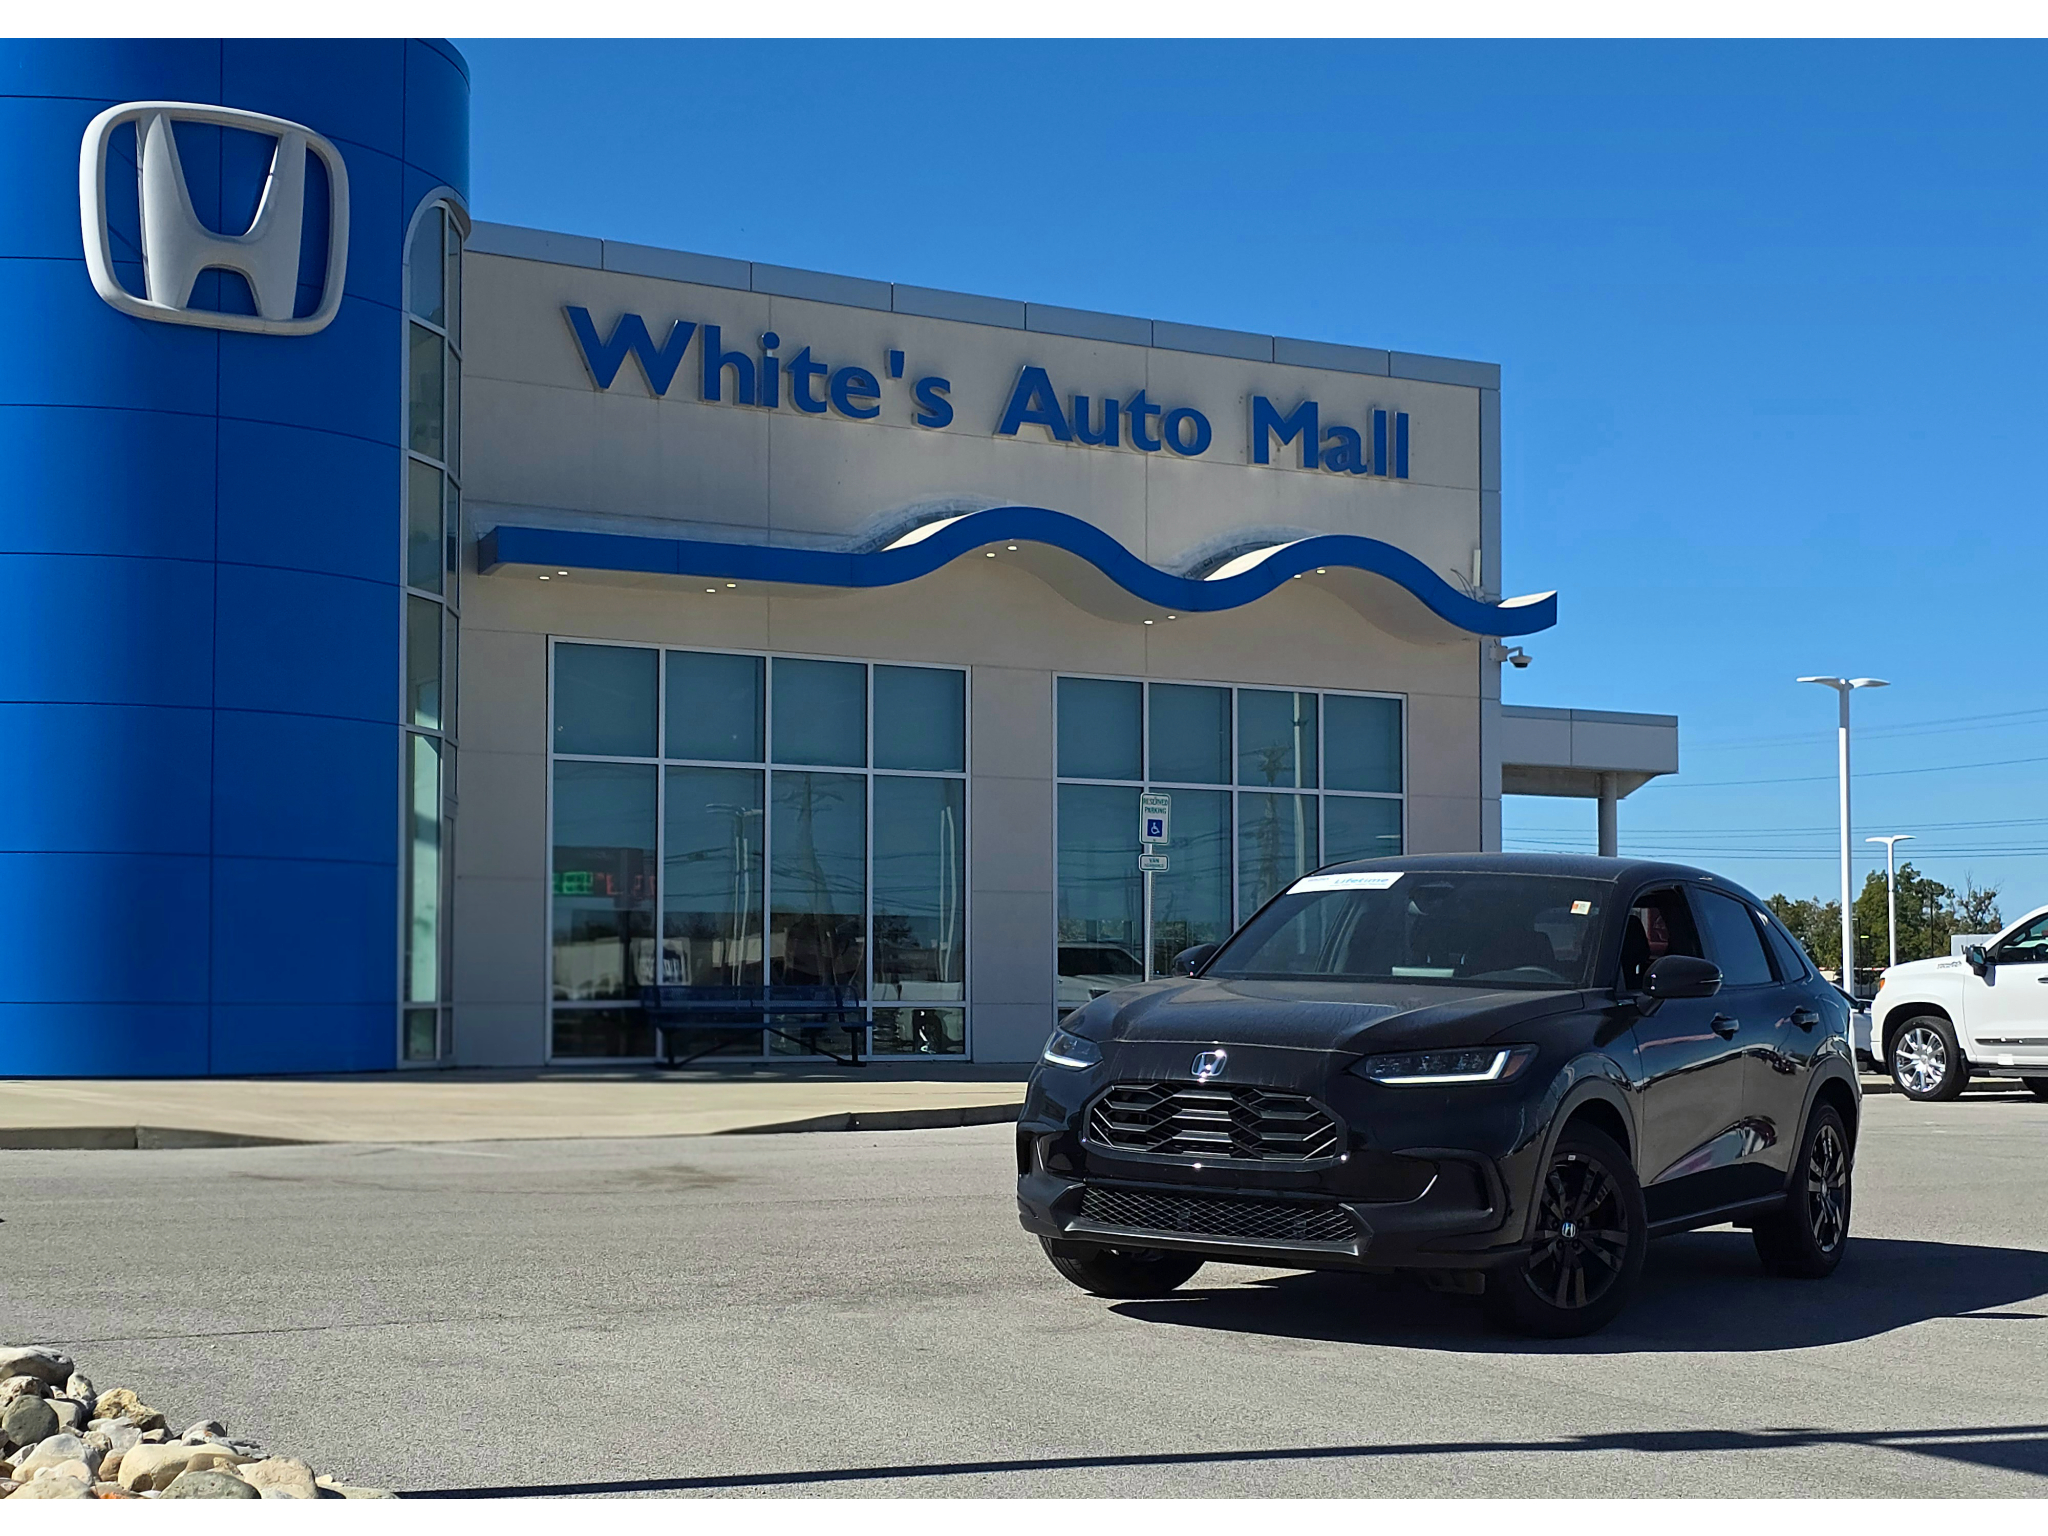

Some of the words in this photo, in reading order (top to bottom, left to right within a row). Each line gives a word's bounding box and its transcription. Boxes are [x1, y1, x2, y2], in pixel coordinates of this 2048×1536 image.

[564, 305, 954, 430] White's
[996, 365, 1213, 458] Auto
[1249, 393, 1410, 481] Mall
[1144, 806, 1167, 814] PARKING
